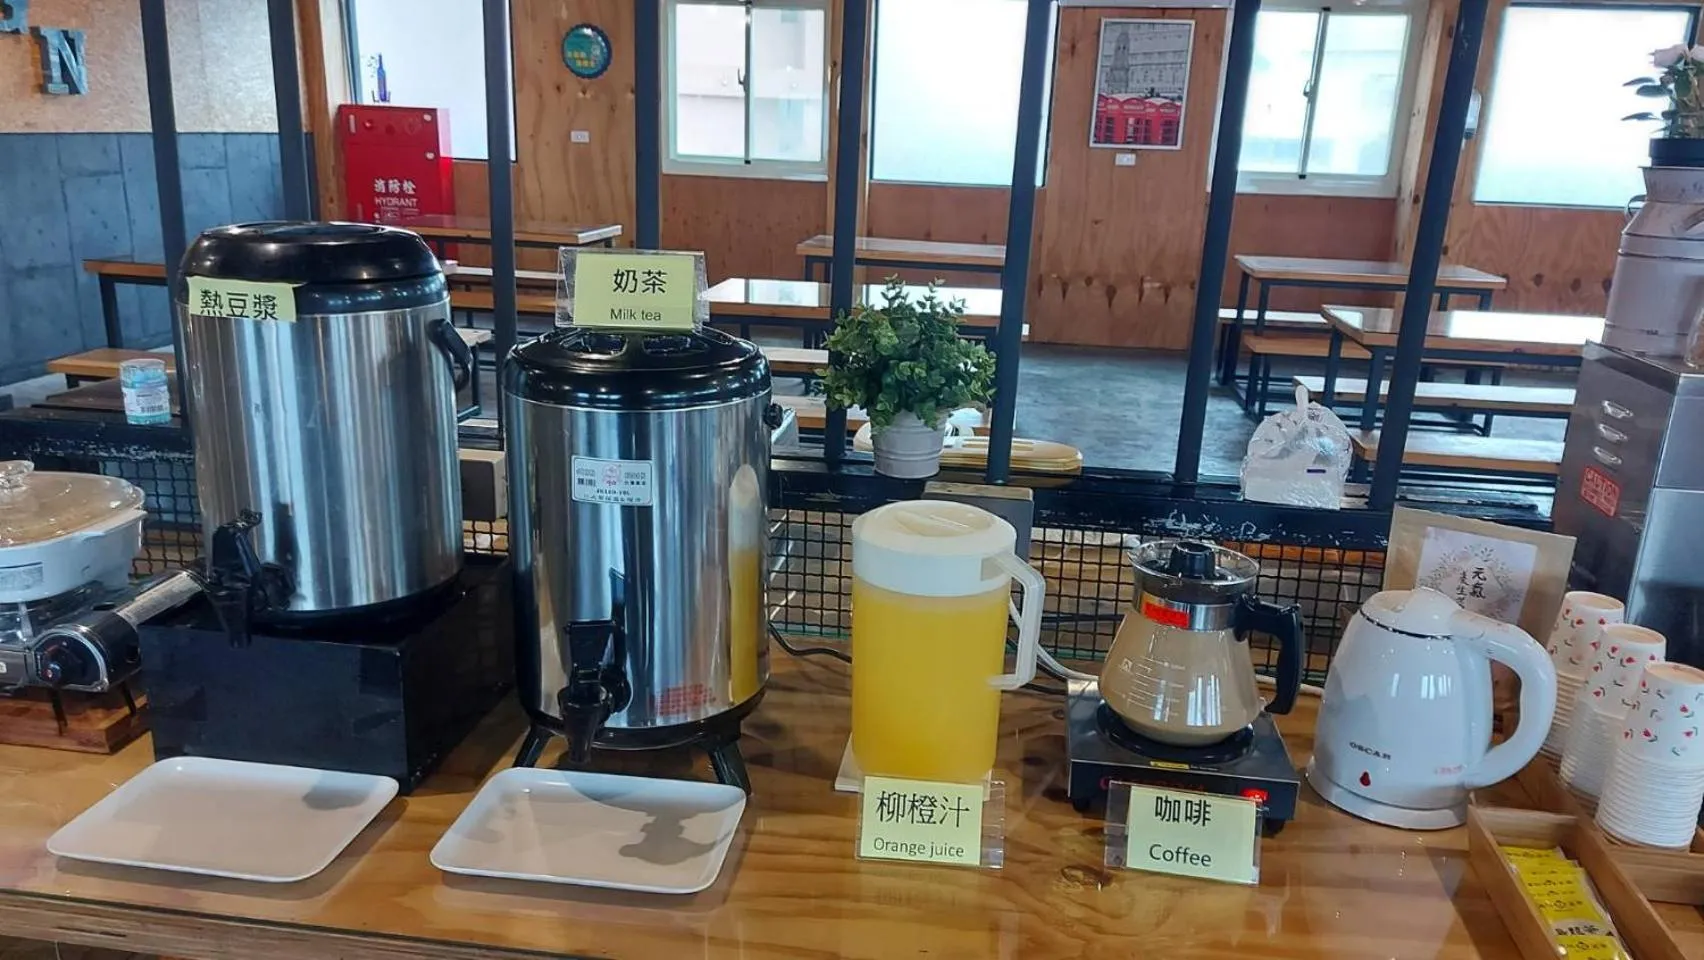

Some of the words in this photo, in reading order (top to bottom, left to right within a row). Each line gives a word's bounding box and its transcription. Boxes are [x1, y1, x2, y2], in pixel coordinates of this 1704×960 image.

[374, 178, 416, 194] 消防栓
[374, 197, 418, 207] HYDRANT
[612, 268, 668, 294] 奶茶
[200, 288, 278, 321] 熱豆漿
[610, 308, 637, 321] Milk
[641, 309, 662, 321] tea
[1348, 741, 1392, 761] OSCAR
[875, 789, 971, 828] 柳橙汁
[1154, 795, 1213, 827] 咖啡
[873, 837, 926, 857] Orange
[929, 841, 964, 858] juice
[1149, 843, 1212, 867] Coffee
